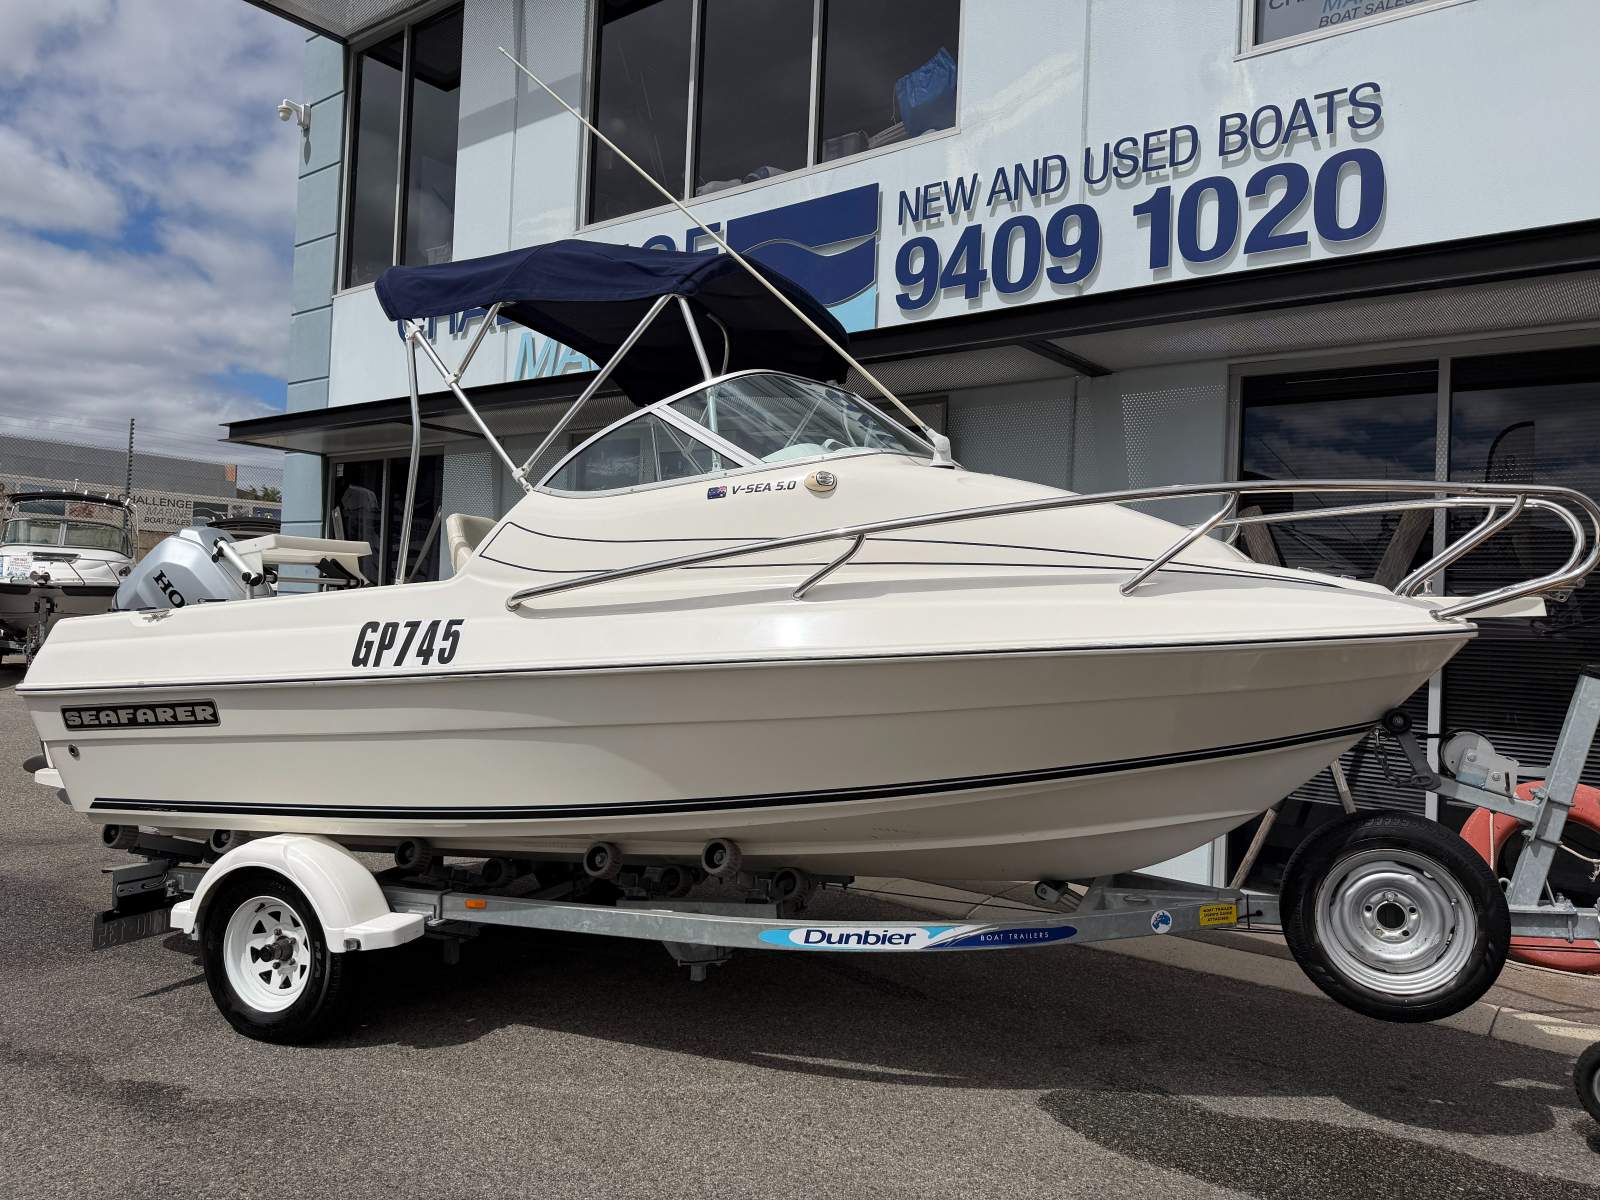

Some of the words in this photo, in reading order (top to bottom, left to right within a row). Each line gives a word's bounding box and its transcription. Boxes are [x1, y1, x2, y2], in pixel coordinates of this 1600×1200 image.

[1318, 6, 1361, 29] BOAT
[898, 173, 979, 226] NEW
[986, 154, 1068, 207] AND
[1084, 124, 1200, 185] USED
[1218, 82, 1383, 157] BOATS
[894, 203, 1102, 312] 9409
[1132, 147, 1386, 270] 1020
[731, 482, 772, 495] V-SEA
[775, 480, 797, 491] 5.0
[144, 516, 166, 525] BOAT
[167, 518, 192, 527] SALES
[351, 618, 465, 668] GP745
[64, 705, 216, 726] SEAFARER
[803, 929, 917, 945] Dunbier
[980, 933, 1004, 942] BOAT
[1008, 931, 1049, 940] TRAILERS
